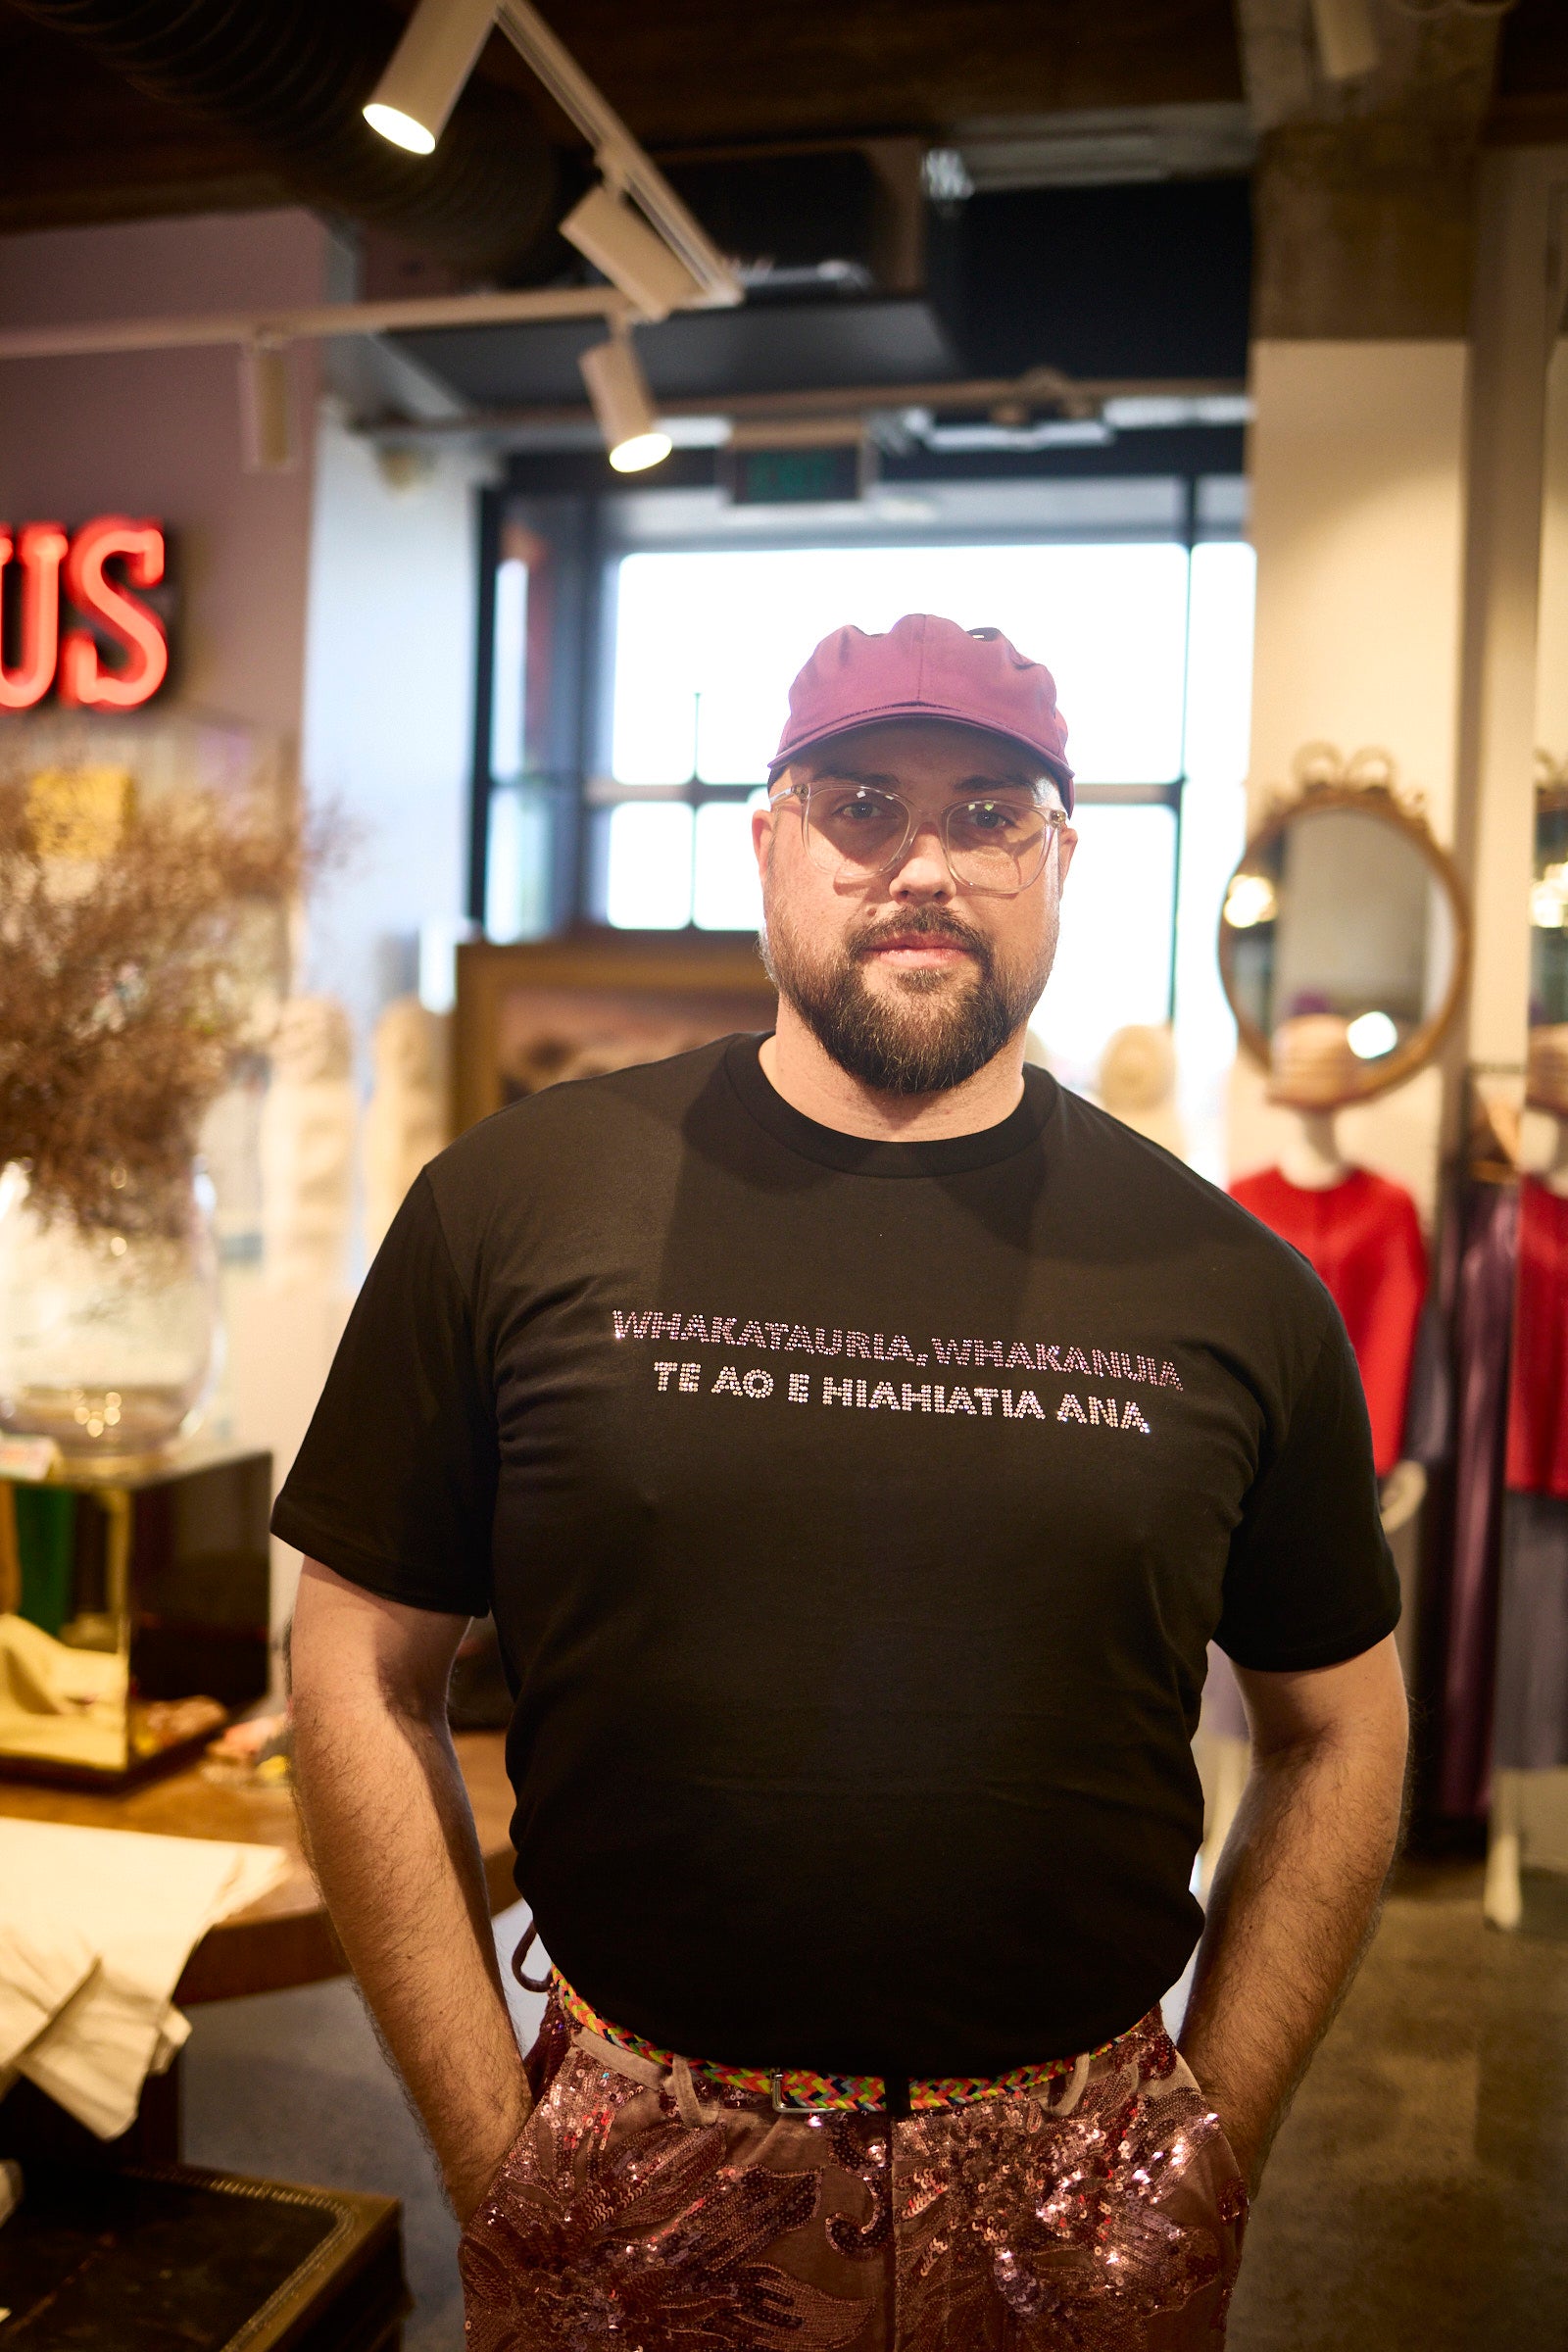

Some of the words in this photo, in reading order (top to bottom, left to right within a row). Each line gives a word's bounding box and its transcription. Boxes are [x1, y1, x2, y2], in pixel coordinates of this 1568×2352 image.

[612, 1309, 928, 1366] WHAKATAURIA,
[931, 1337, 1184, 1392] WHAKANUIA
[654, 1361, 702, 1392] TE
[710, 1366, 774, 1398] AO
[788, 1373, 810, 1402] E
[822, 1376, 1046, 1420] HIAHIATIA
[1056, 1393, 1151, 1434] ANA
